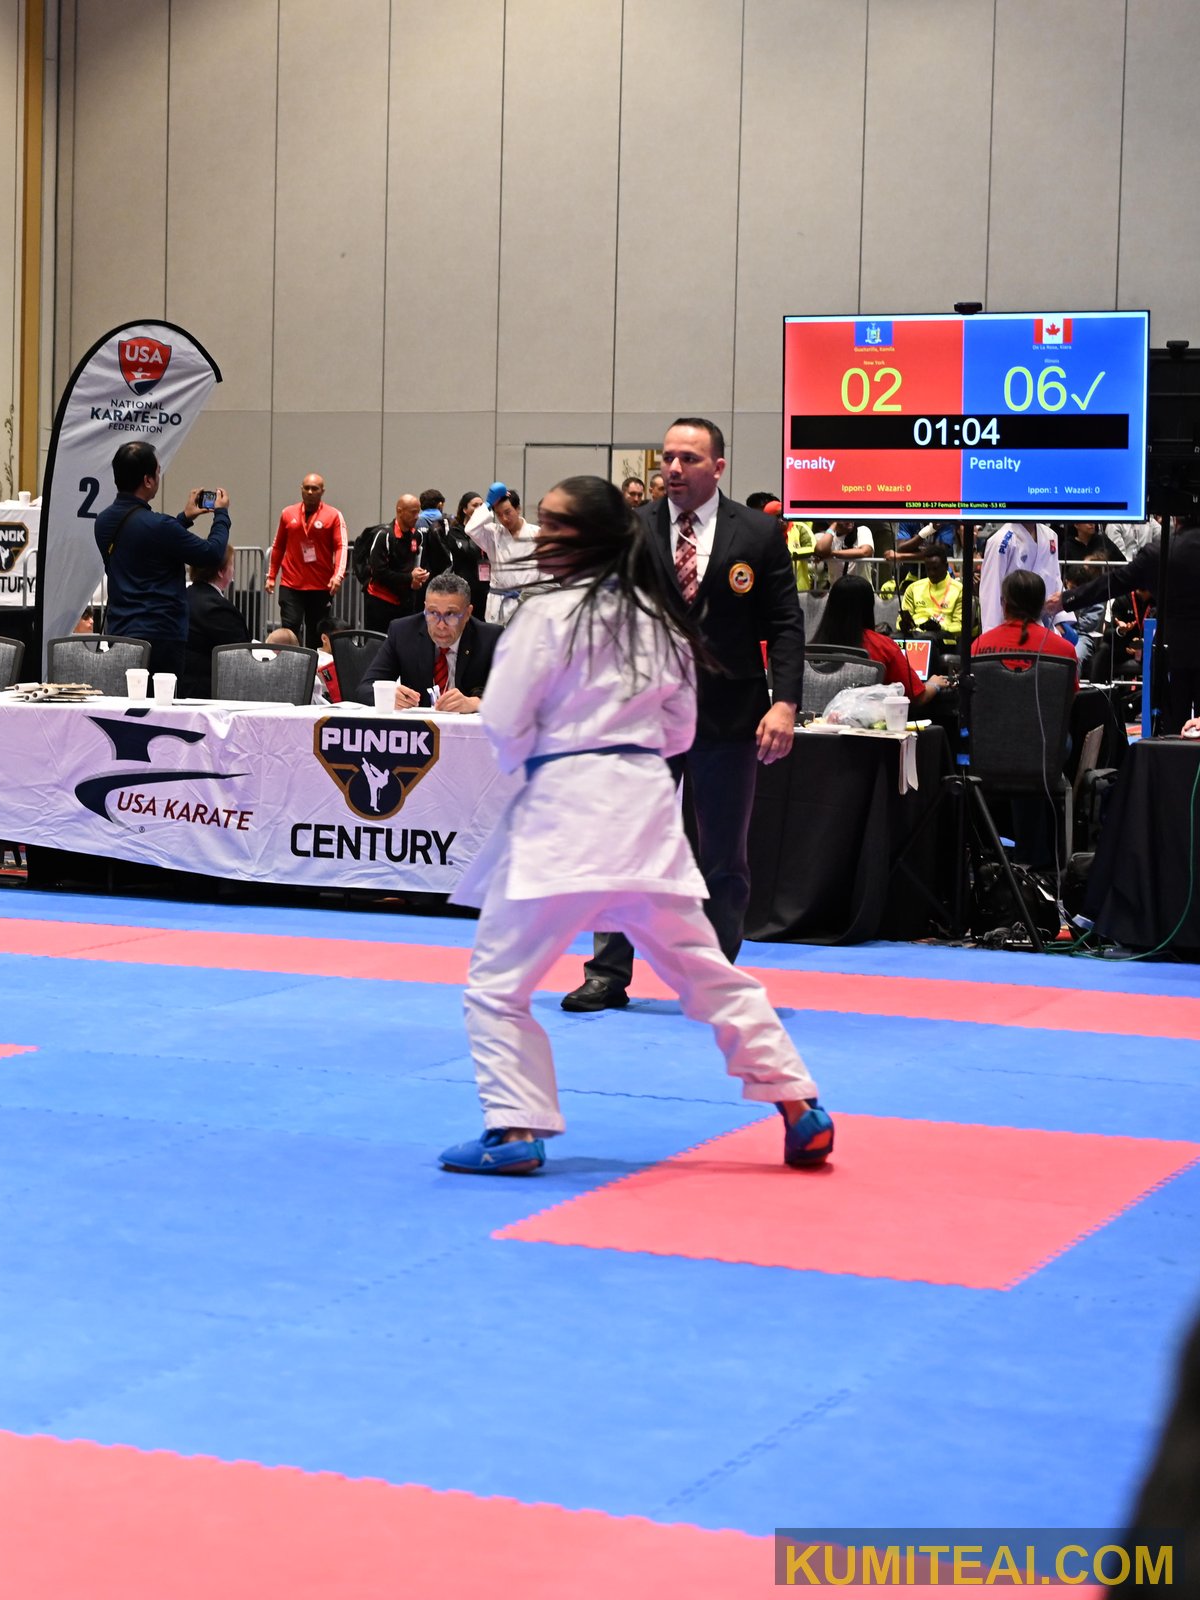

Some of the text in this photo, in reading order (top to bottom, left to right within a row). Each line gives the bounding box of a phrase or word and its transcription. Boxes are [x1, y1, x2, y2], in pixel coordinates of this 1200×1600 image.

[125, 345, 163, 364] USA
[841, 367, 902, 412] 02
[1004, 366, 1067, 411] 06
[110, 398, 165, 411] NATIONAL
[90, 406, 182, 426] KARATE-DO
[108, 422, 163, 434] FEDERATION
[913, 417, 1000, 446] 01:04
[785, 456, 835, 472] Penalty
[969, 456, 1021, 472] Penalty
[77, 476, 100, 519] 2
[842, 485, 865, 493] Ippon:
[1028, 486, 1052, 495] Ippon:
[321, 727, 432, 755] PUNOK
[116, 791, 254, 831] USA KARATE
[290, 823, 457, 865] CENTURY
